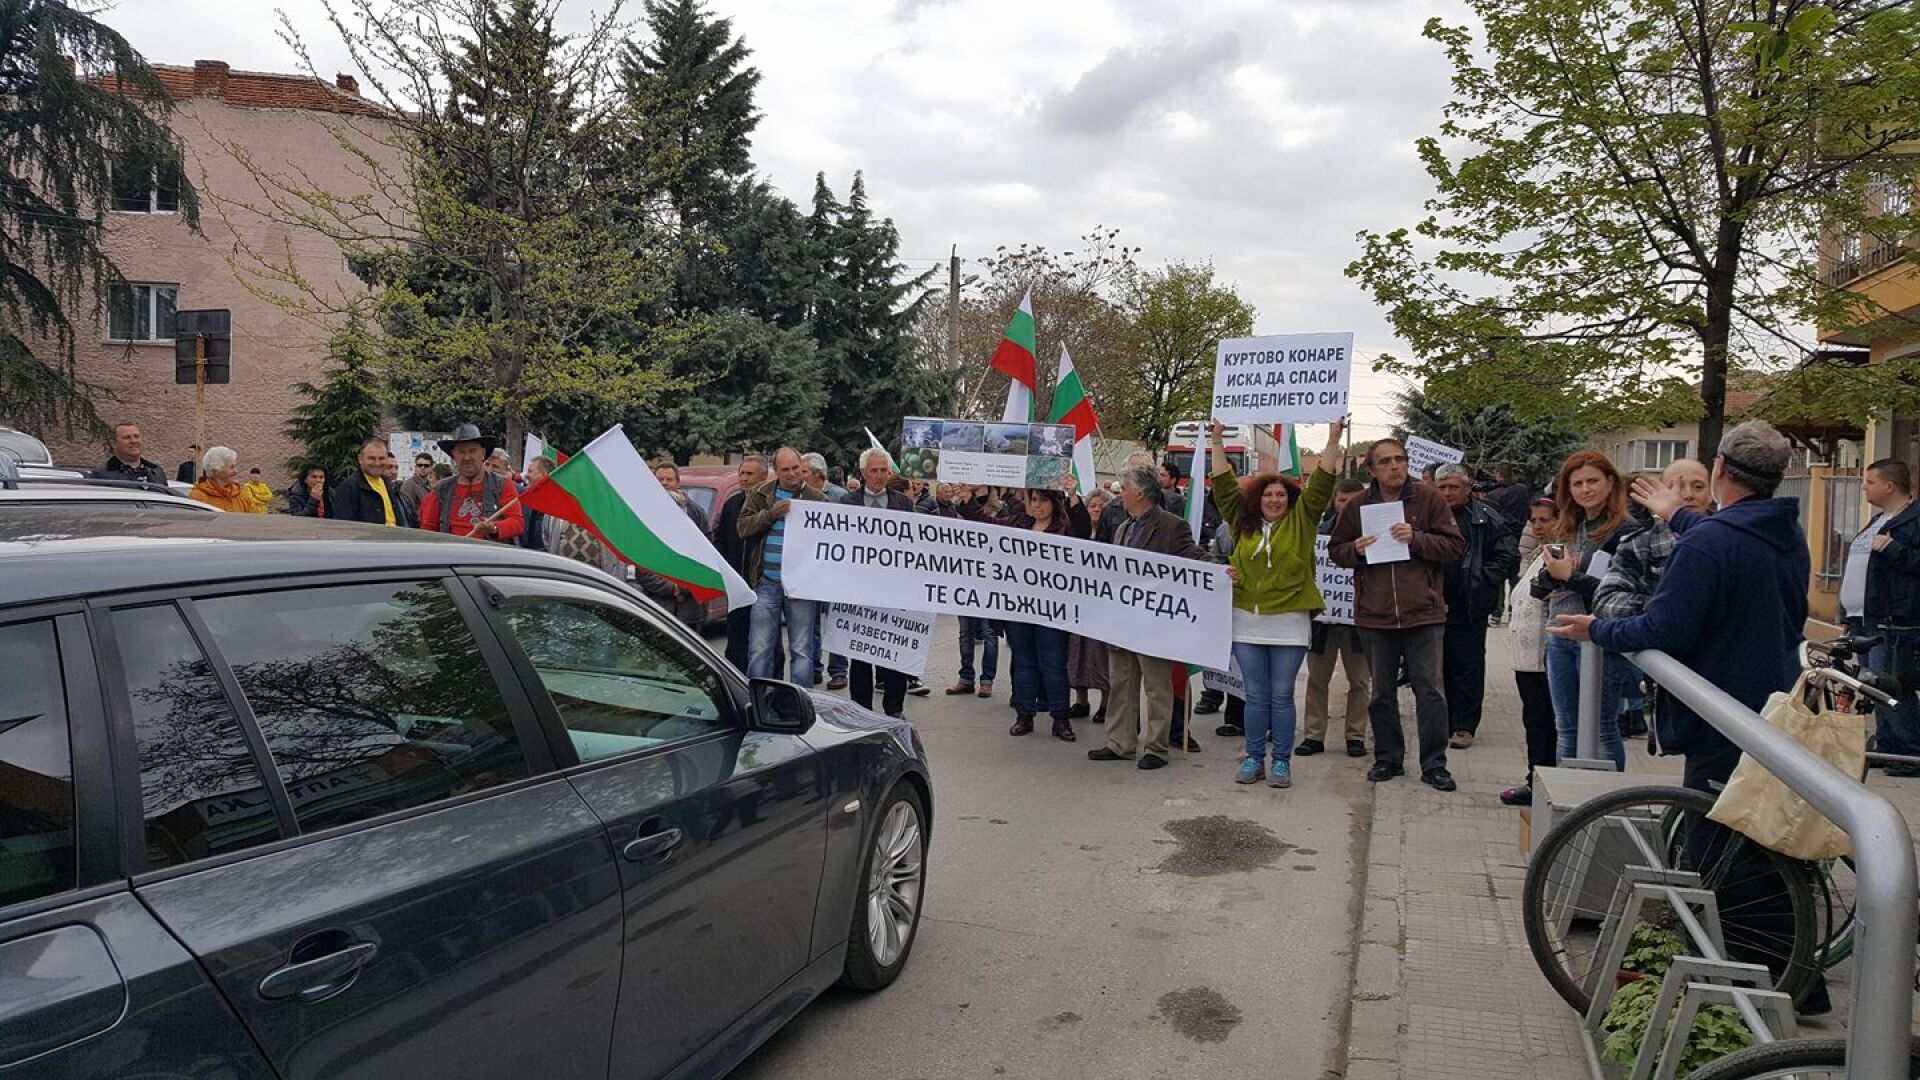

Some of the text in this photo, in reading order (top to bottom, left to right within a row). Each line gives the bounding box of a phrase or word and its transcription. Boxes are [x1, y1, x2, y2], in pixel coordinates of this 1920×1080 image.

[1224, 347, 1344, 366] КУРТОВО КОНАРЕ
[1227, 369, 1337, 388] ИСКА ДА СПАСИ
[1215, 391, 1315, 409] ЗЕМЕДЕЛИЕТО
[1319, 391, 1338, 405] СИ
[803, 510, 1214, 591] ЖАН-КЛОД ЮНКЕР, СПРЕТЕ ИМ ПАРИТЕ
[815, 542, 1197, 623] ПО ПРОГРАМИТЕ ЗА ОКОЛНА СРЕДА,
[832, 602, 930, 635] ДОМАТИ И ЧУШКИ
[925, 583, 1079, 623] ТЕ СА ЛЪЖЦИ !
[836, 618, 920, 650] СА ИЗВЕСТНИ В
[849, 639, 891, 661] ЕВРОПА
